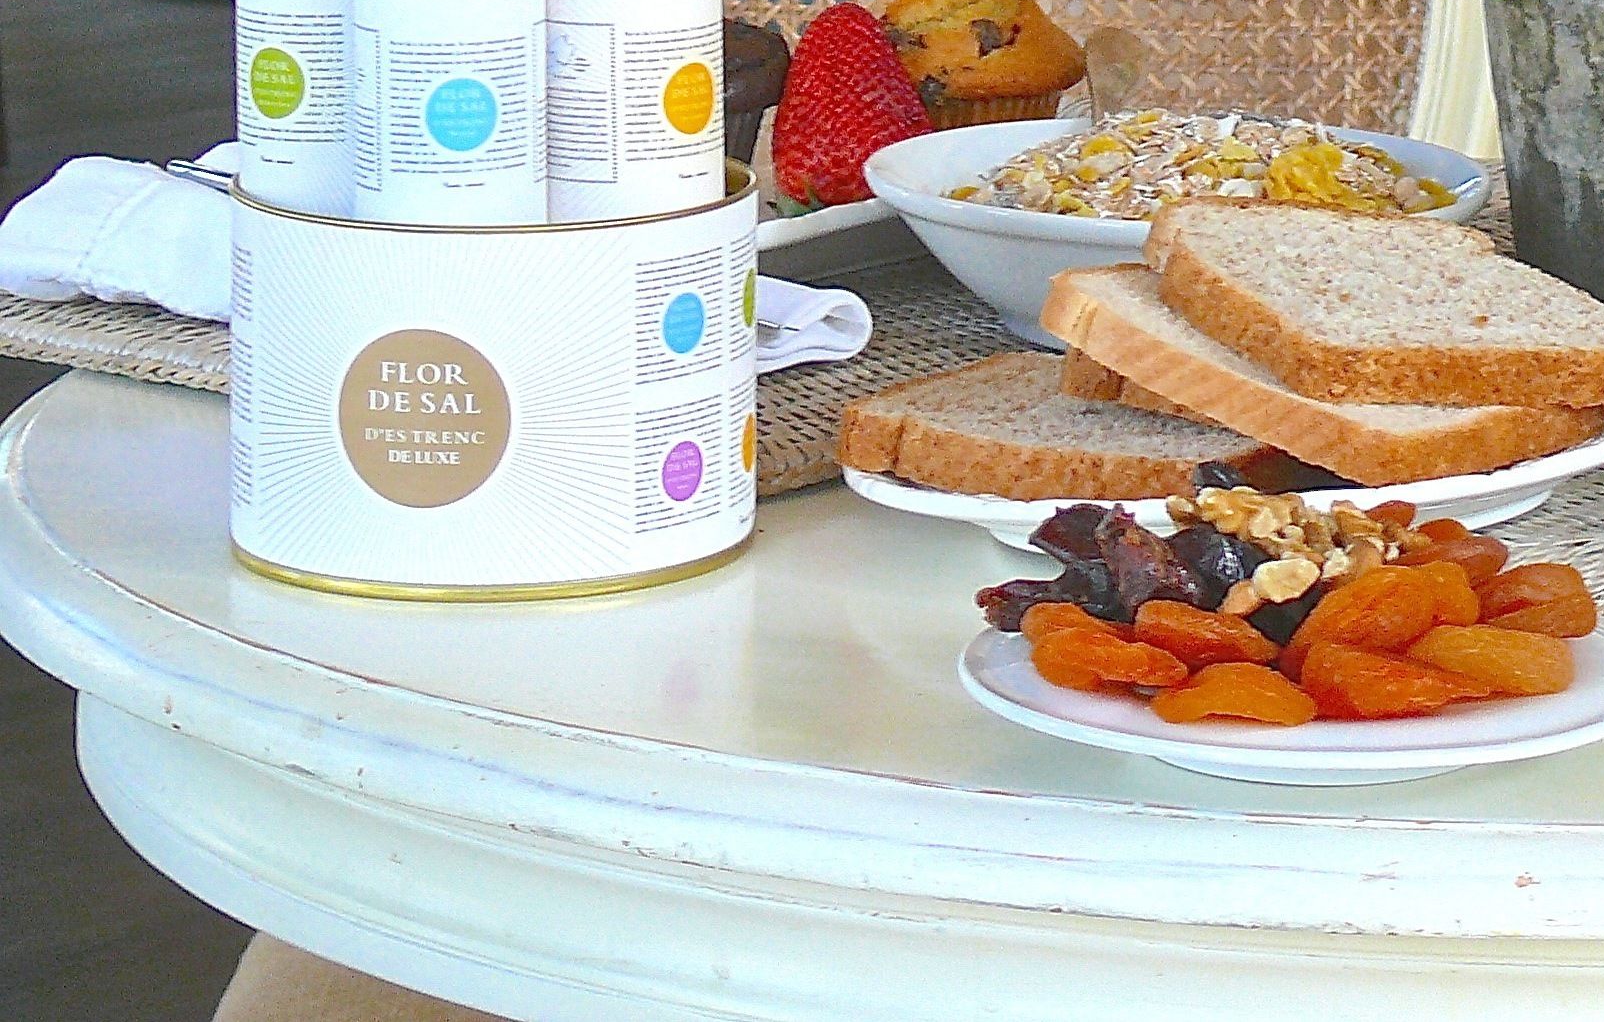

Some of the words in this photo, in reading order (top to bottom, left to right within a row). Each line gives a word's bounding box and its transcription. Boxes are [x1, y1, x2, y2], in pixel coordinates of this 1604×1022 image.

[380, 361, 469, 385] FLOR
[367, 389, 411, 413] DE
[420, 392, 482, 414] SAL
[364, 427, 408, 443] D'ES
[412, 430, 486, 445] TRENC
